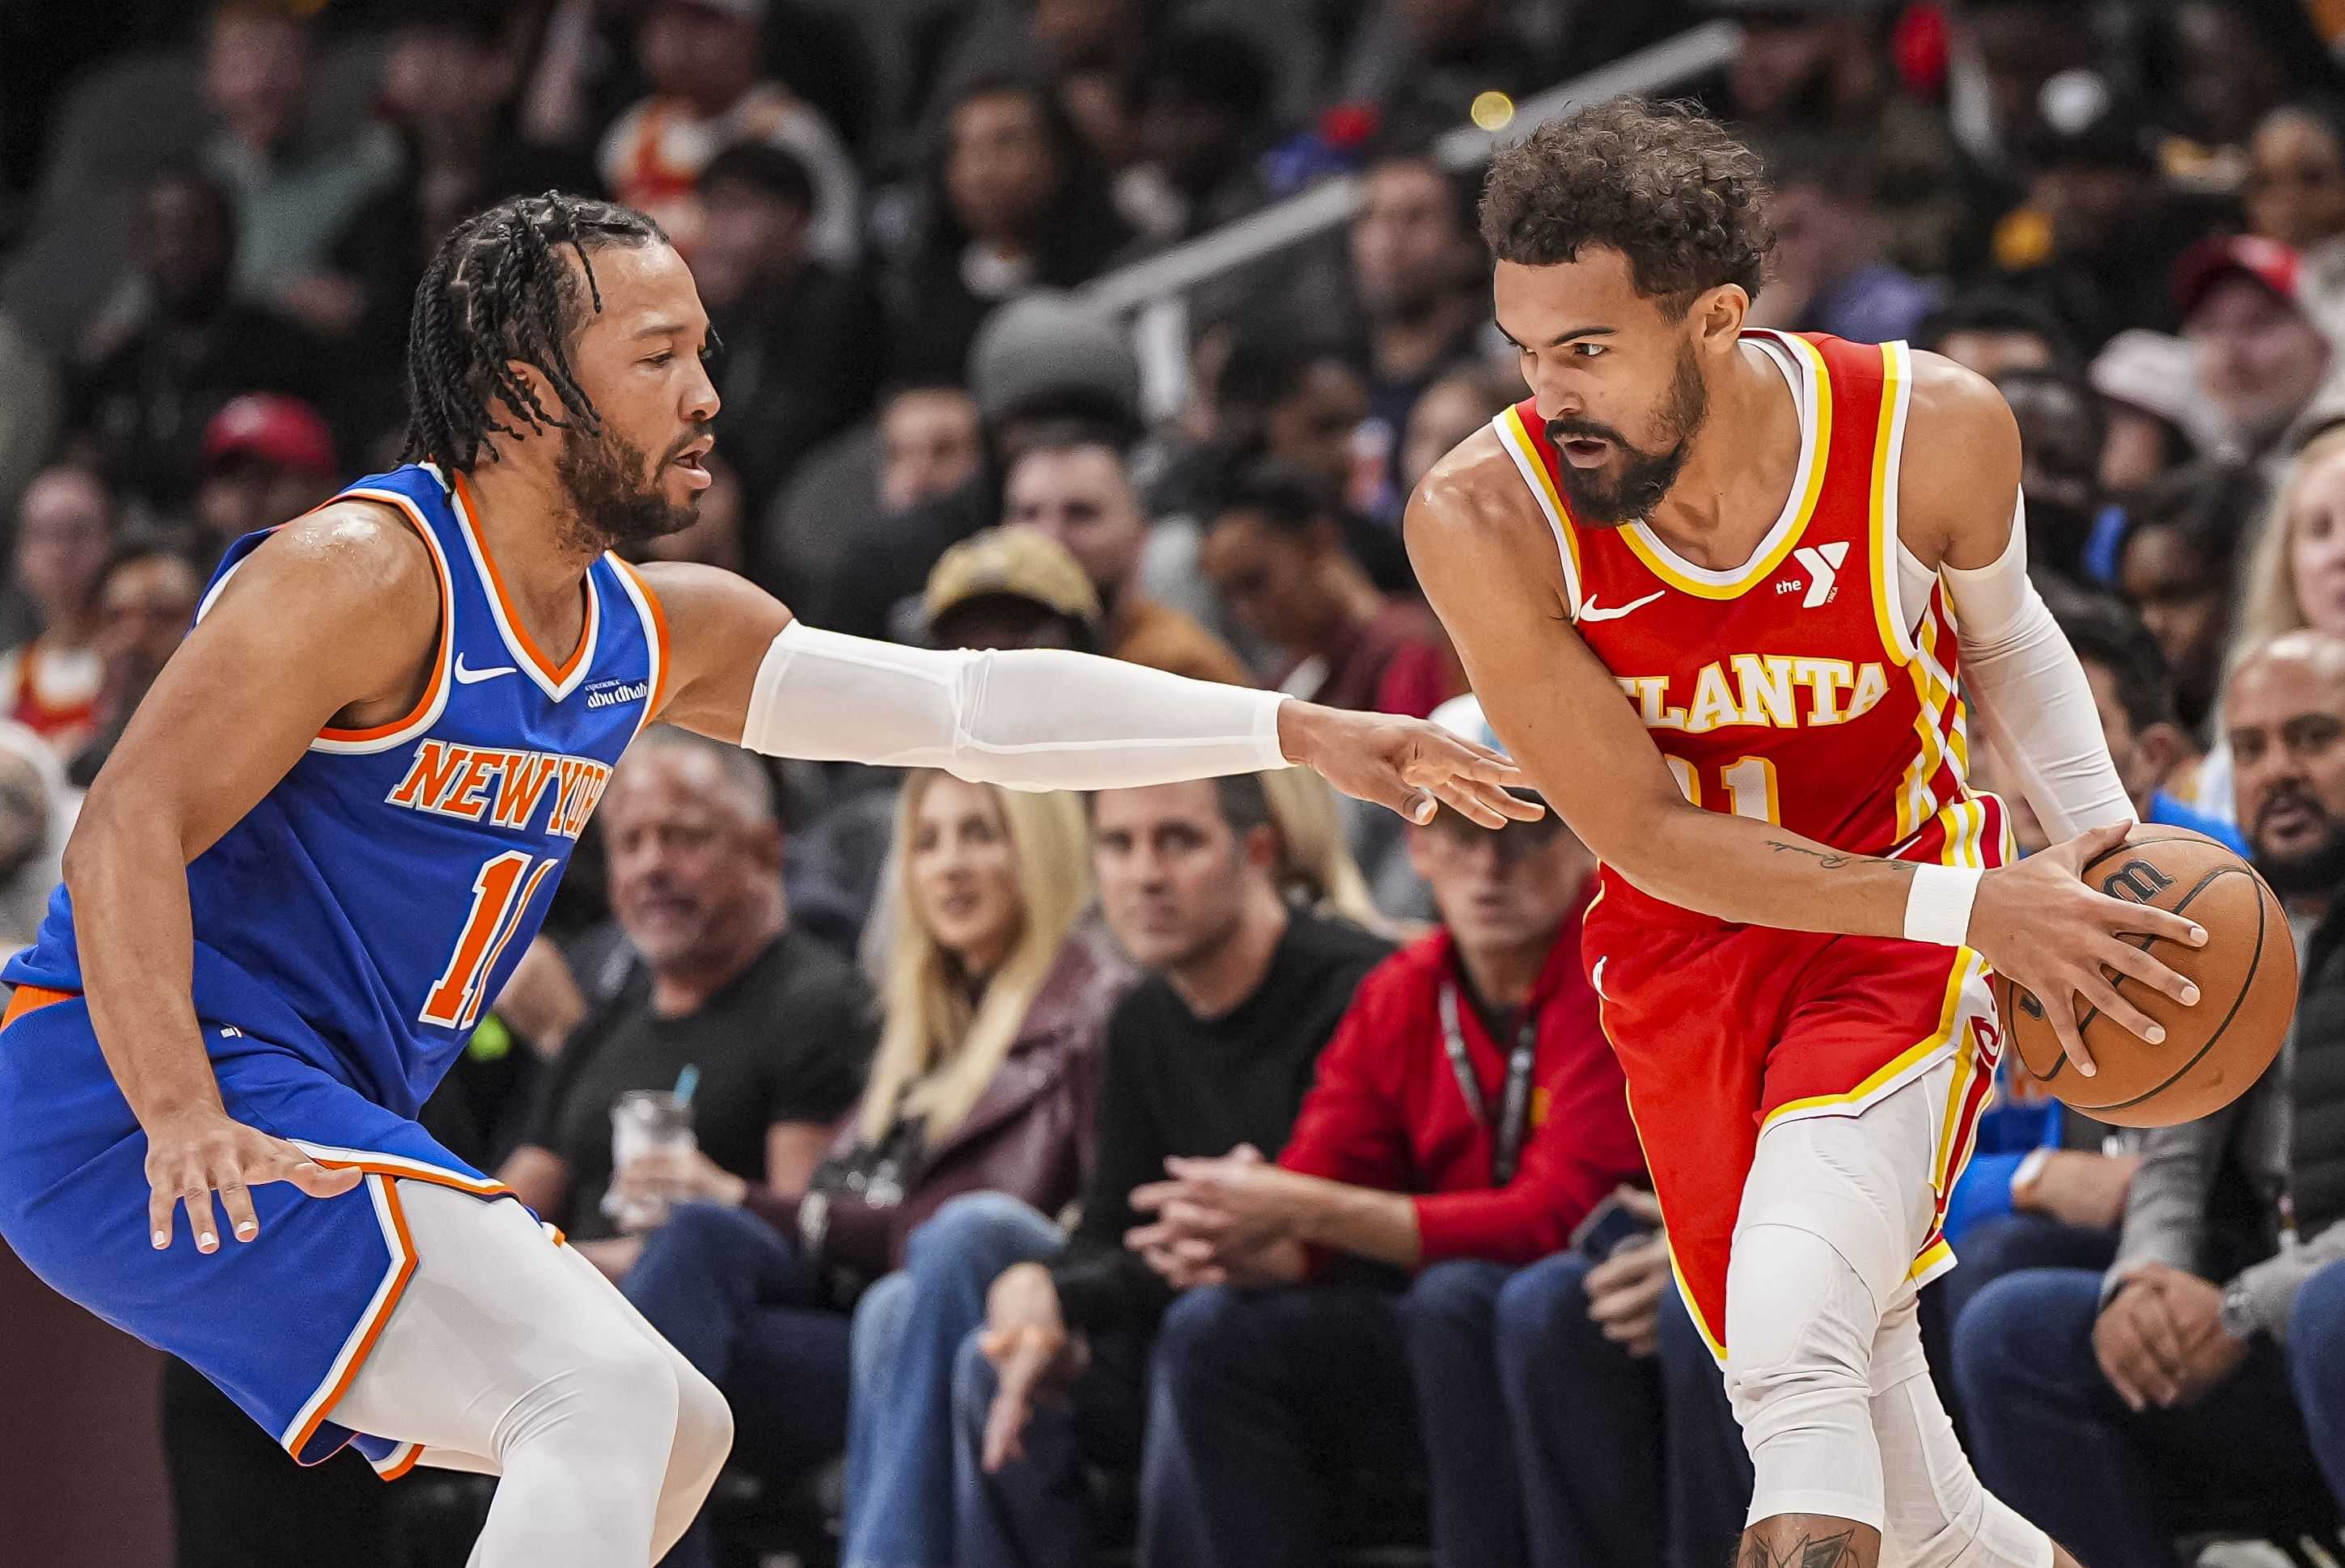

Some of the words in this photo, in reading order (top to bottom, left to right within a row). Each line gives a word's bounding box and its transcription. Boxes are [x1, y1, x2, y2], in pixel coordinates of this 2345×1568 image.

[1776, 580, 1801, 594] the
[587, 691, 615, 708] abu
[615, 682, 647, 702] dhab
[1613, 653, 1890, 733] LANTA
[384, 738, 561, 830] NEW
[544, 754, 614, 843] YOR
[1664, 754, 1781, 826] 1
